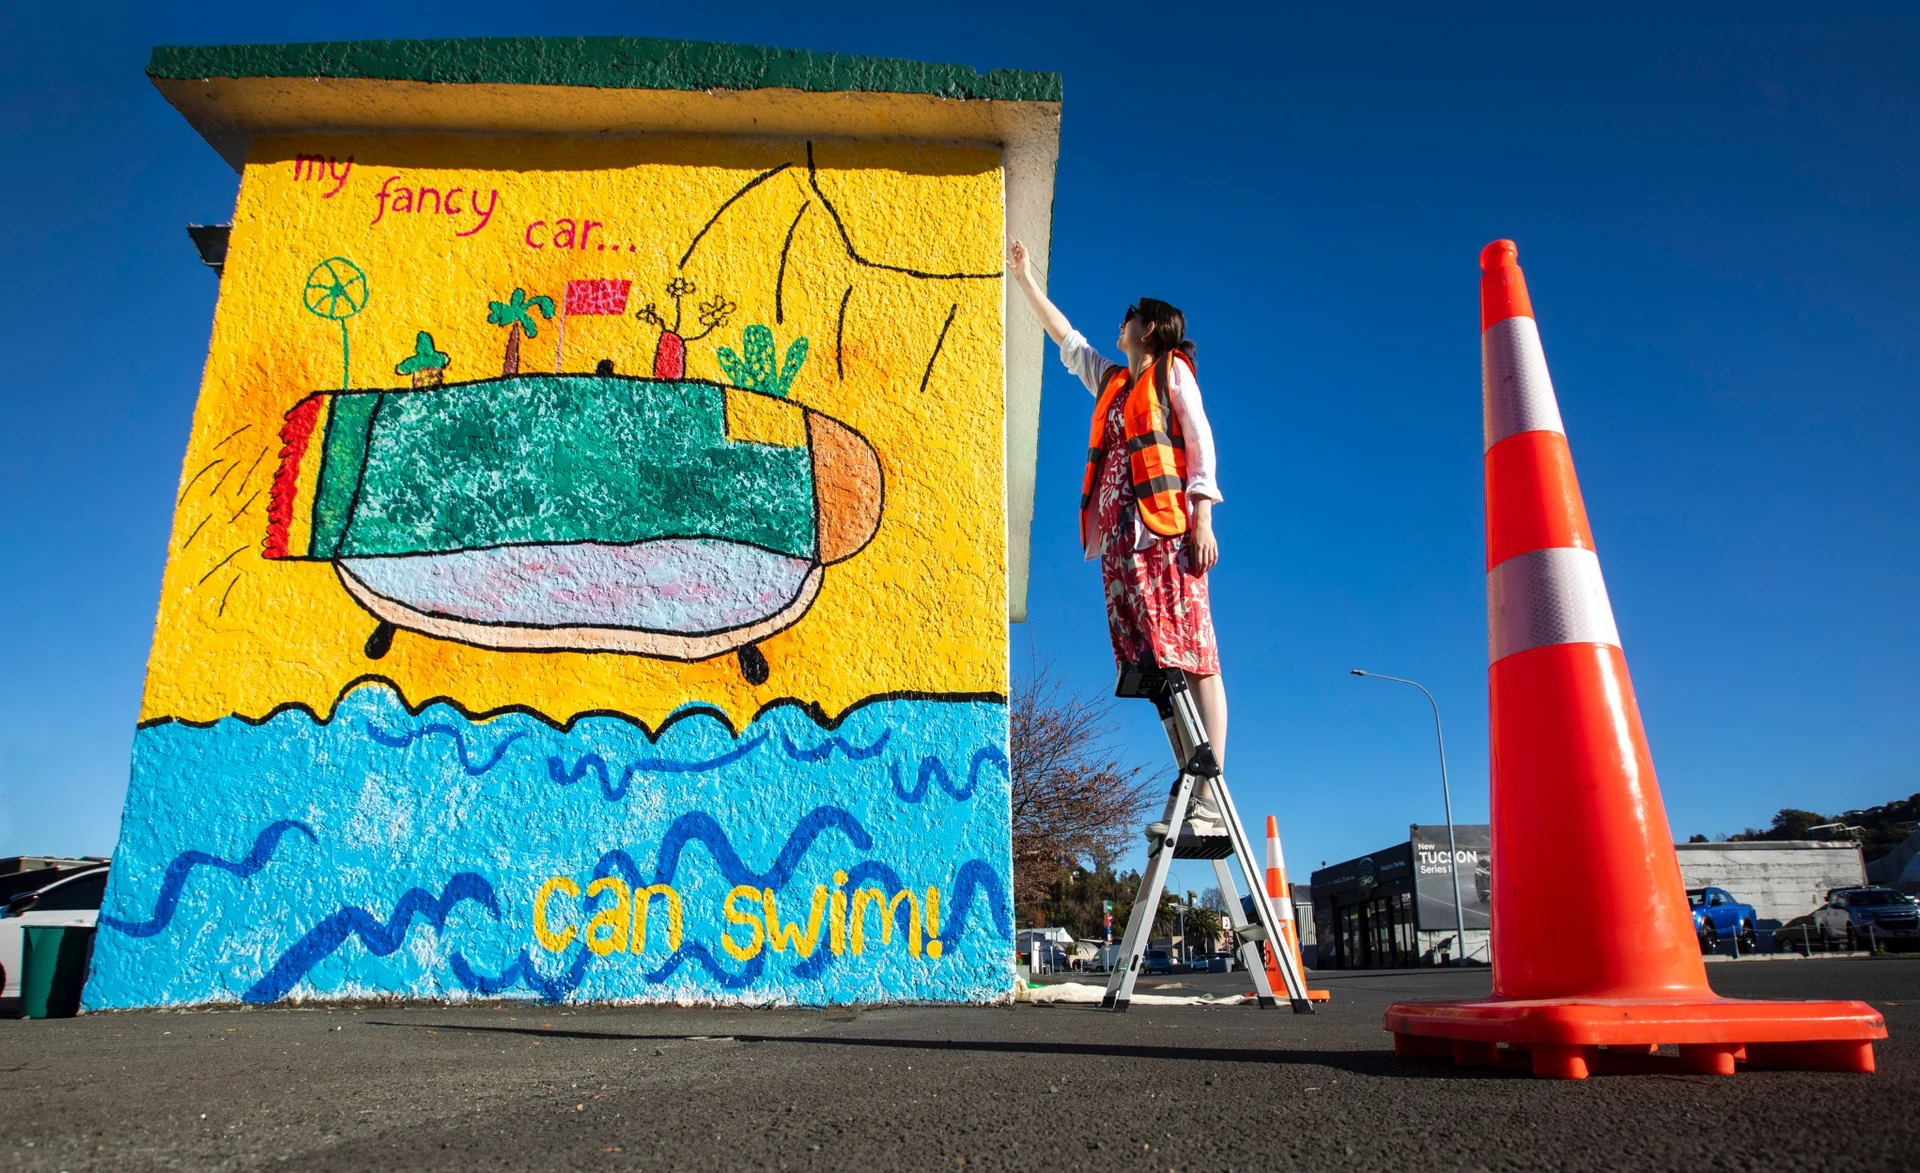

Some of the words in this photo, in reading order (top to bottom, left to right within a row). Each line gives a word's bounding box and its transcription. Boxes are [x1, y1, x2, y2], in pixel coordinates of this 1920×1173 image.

[293, 153, 354, 199] my
[370, 175, 498, 237] fancy
[525, 218, 637, 253] car...
[533, 876, 683, 956] can
[720, 869, 943, 962] swim!
[1420, 865, 1447, 874] Series
